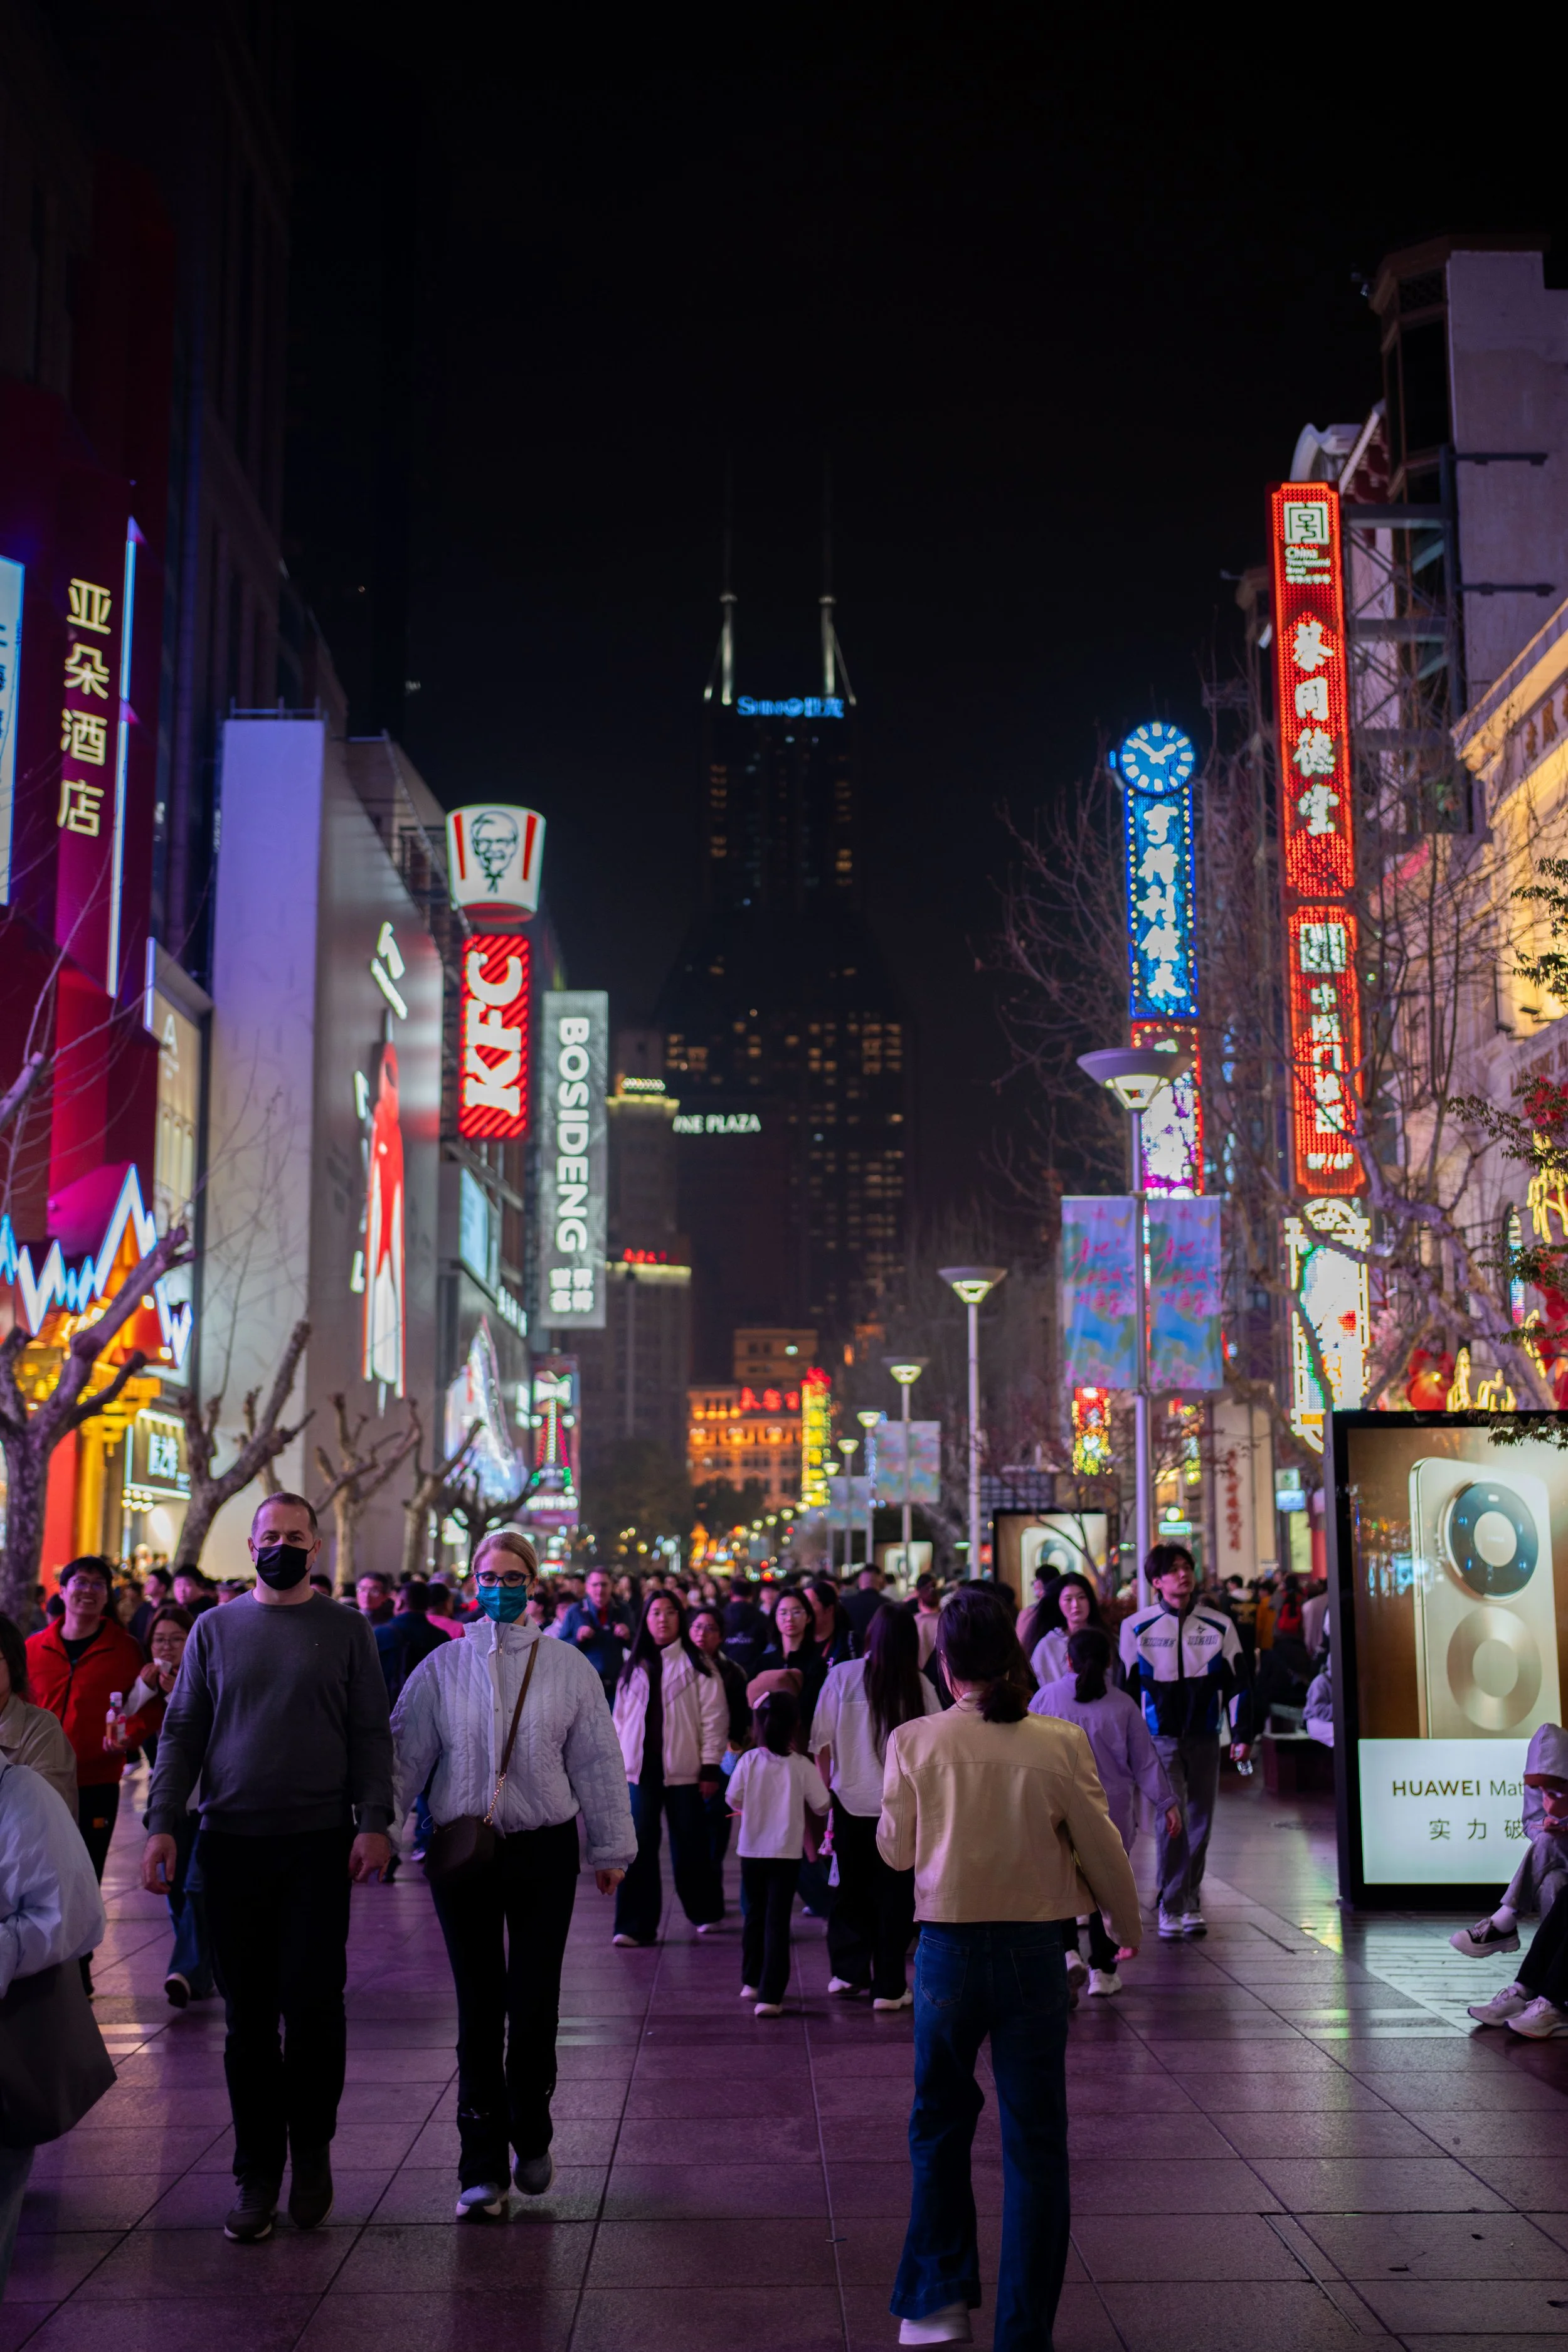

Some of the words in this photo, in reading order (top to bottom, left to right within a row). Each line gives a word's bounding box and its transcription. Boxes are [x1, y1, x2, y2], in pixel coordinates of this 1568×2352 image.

[57, 578, 112, 837] 亚朵酒店
[464, 950, 523, 1117] KFC
[556, 1017, 590, 1253] BOSIDENG
[706, 1114, 761, 1133] PLAZA
[1393, 1780, 1480, 1796] HUAWEI
[1490, 1780, 1524, 1796] Mat
[1429, 1818, 1526, 1840] 实力破
